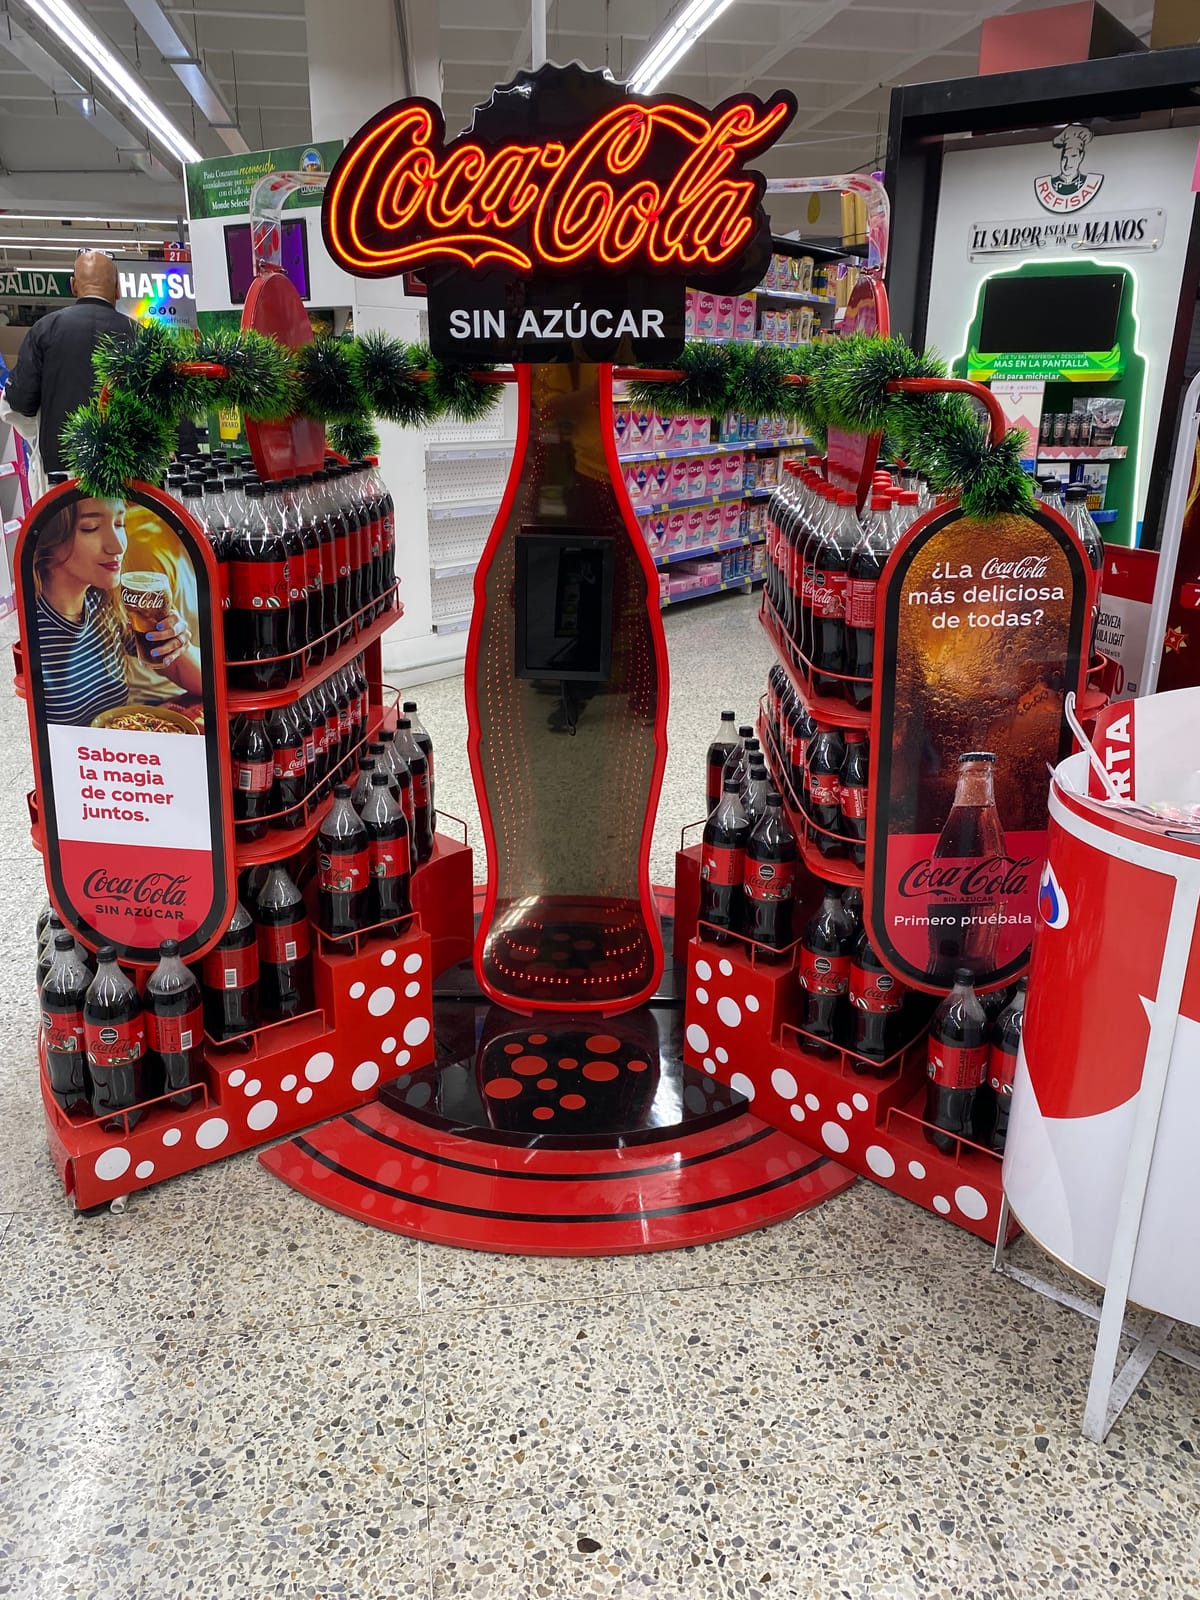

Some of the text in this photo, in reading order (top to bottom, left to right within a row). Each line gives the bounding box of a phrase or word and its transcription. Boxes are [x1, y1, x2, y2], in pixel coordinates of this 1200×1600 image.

[330, 102, 787, 270] Coca-Cola
[1038, 180, 1100, 209] REFISAL
[972, 230, 988, 249] EL
[992, 225, 1043, 249] SABOR
[1079, 218, 1148, 247] MANOS
[169, 252, 181, 262] 21
[119, 272, 196, 300] HATSU
[449, 310, 513, 339] SIN
[517, 302, 665, 339] AZÚCAR
[993, 359, 1089, 368] MAS EN LA PANTALLA
[1006, 373, 1024, 381] para
[1025, 371, 1060, 380] michelar
[931, 555, 1050, 580] ¿La Coca-Cola
[908, 584, 1065, 605] más deliciosa
[931, 608, 1045, 629] de todas?
[77, 746, 161, 766] Saborea
[79, 765, 165, 787] la magia
[81, 785, 174, 806] de comer
[82, 804, 150, 824] juntos.
[898, 855, 1039, 898] Coca-Cola
[82, 868, 192, 907] Coca-Cola
[95, 904, 184, 921] SIN AZÚCAR
[894, 912, 1032, 928] Primero pruébala
